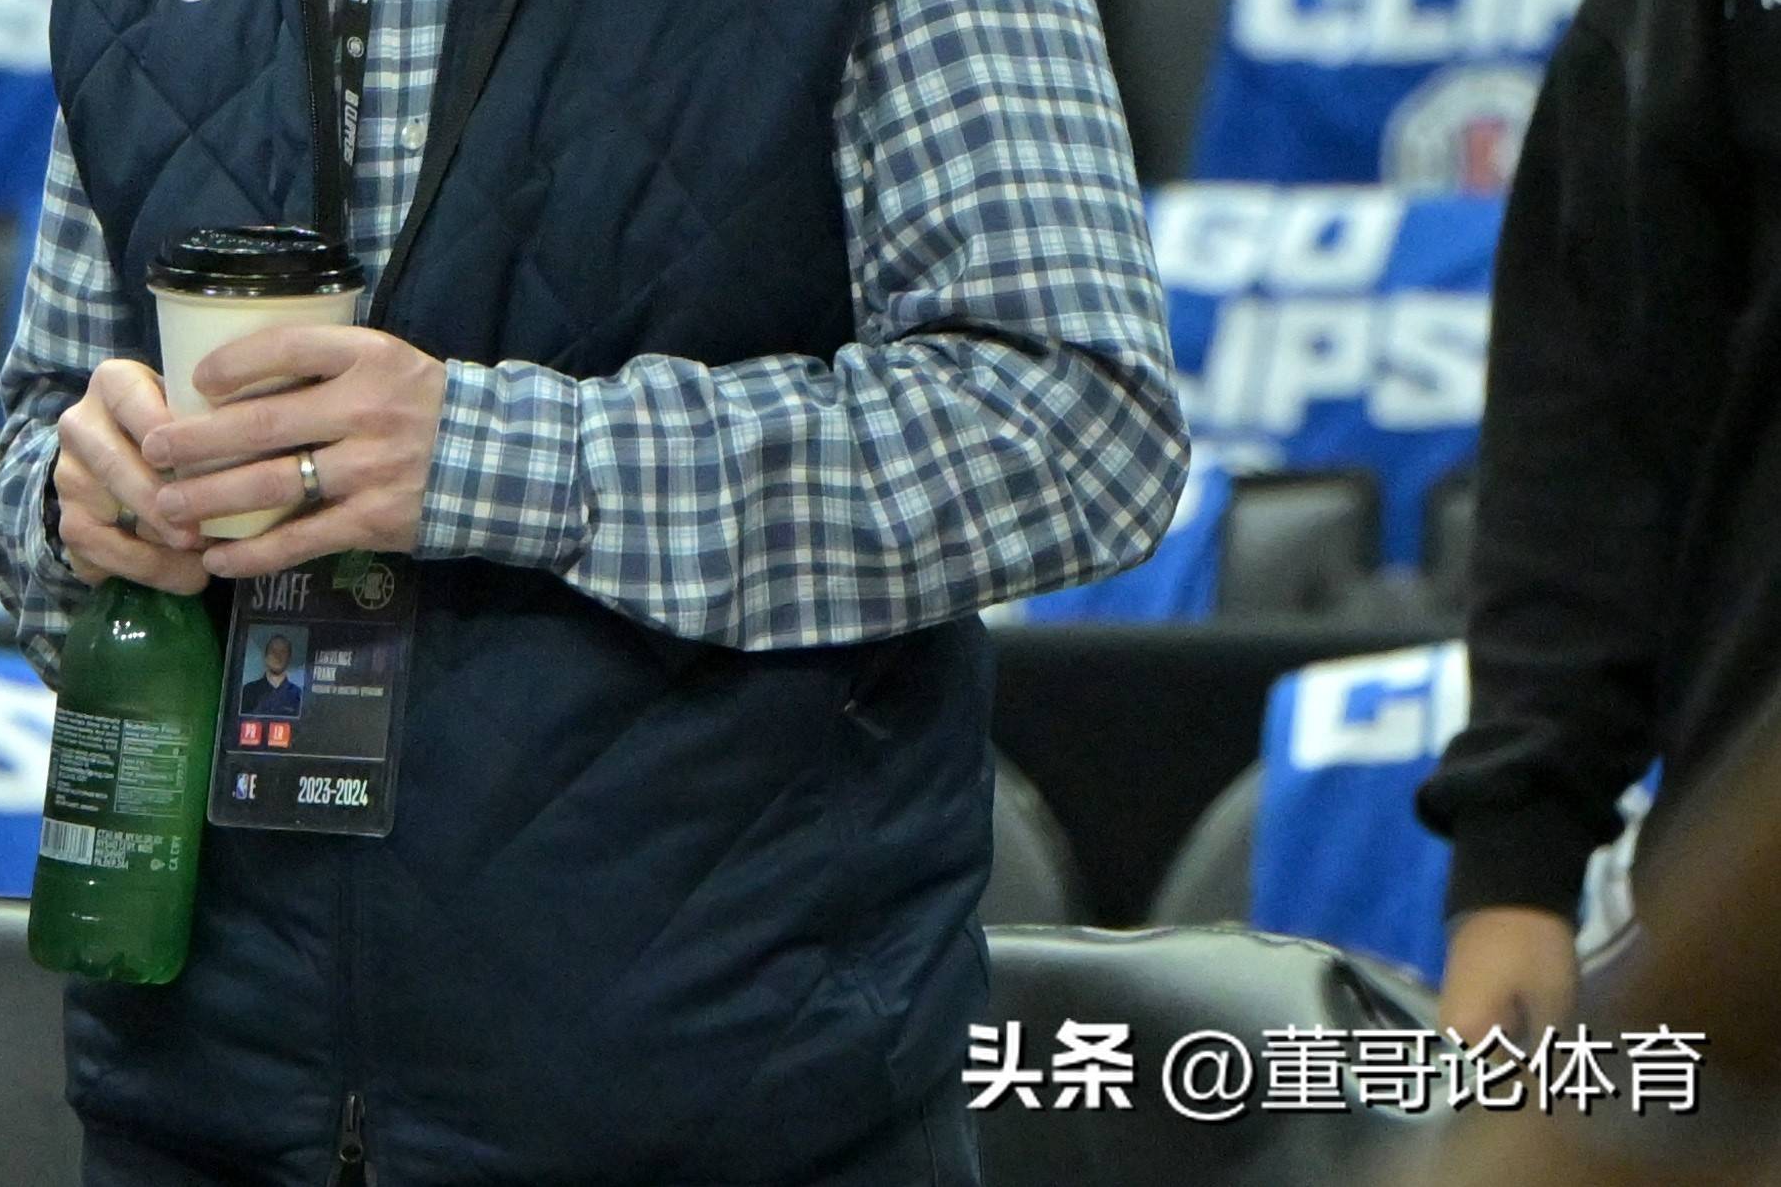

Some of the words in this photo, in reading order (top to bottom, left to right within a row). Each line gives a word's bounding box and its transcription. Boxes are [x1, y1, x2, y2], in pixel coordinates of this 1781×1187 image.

[1148, 185, 1408, 296] GO
[252, 572, 314, 612] STAFF
[297, 775, 368, 807] 2023-2024
